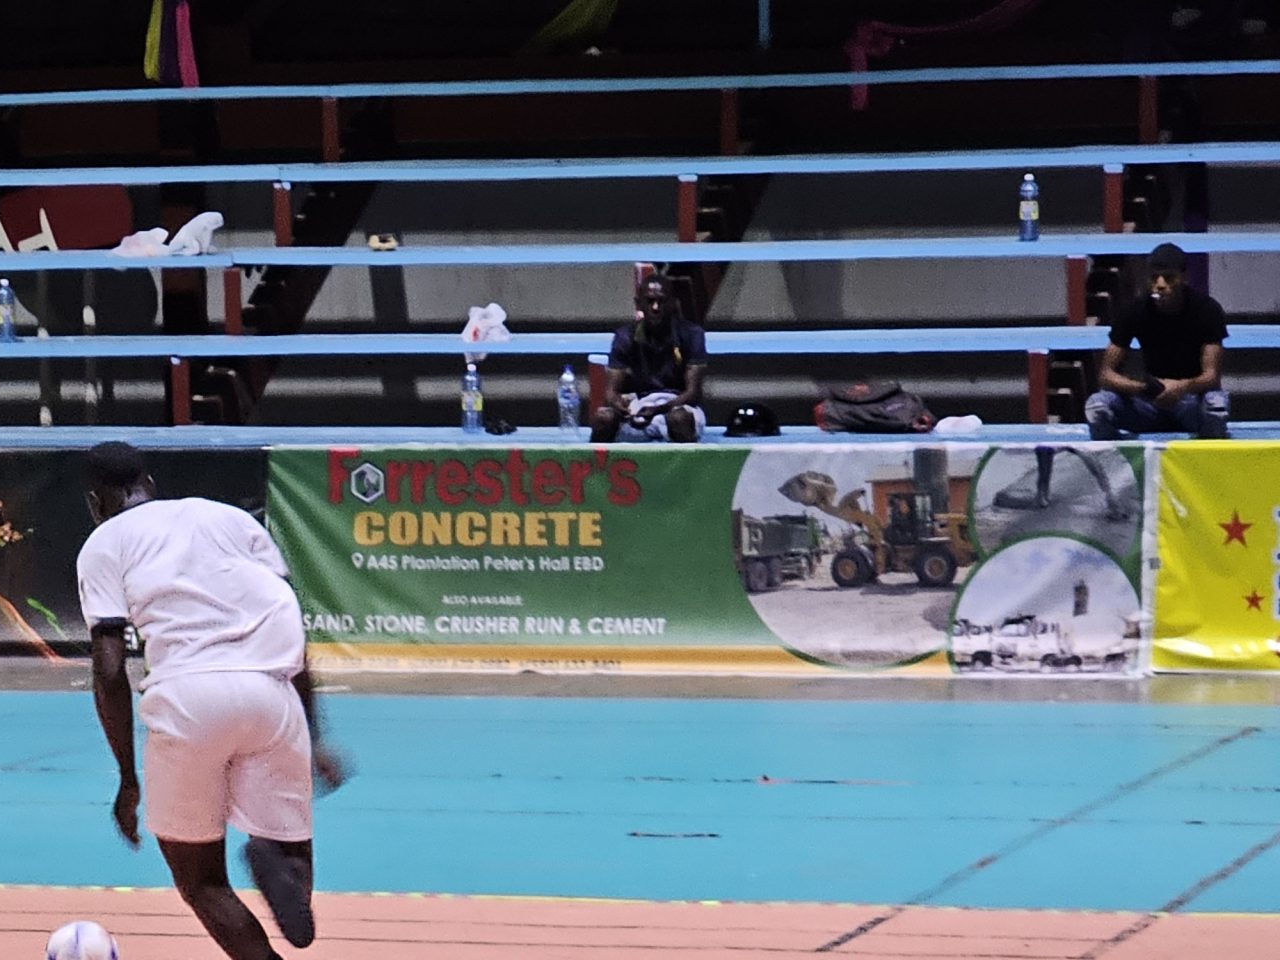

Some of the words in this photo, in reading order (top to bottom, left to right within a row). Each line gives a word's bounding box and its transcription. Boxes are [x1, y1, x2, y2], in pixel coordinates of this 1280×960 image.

[353, 511, 603, 546] CONCRETE
[367, 555, 397, 571] A45
[401, 555, 479, 571] Plantation
[484, 556, 535, 572] Peter's
[539, 556, 569, 572] Hall
[435, 616, 519, 634] CRUSHER
[525, 616, 563, 634] RUN
[569, 618, 581, 634] &
[587, 617, 666, 635] CEMENT
